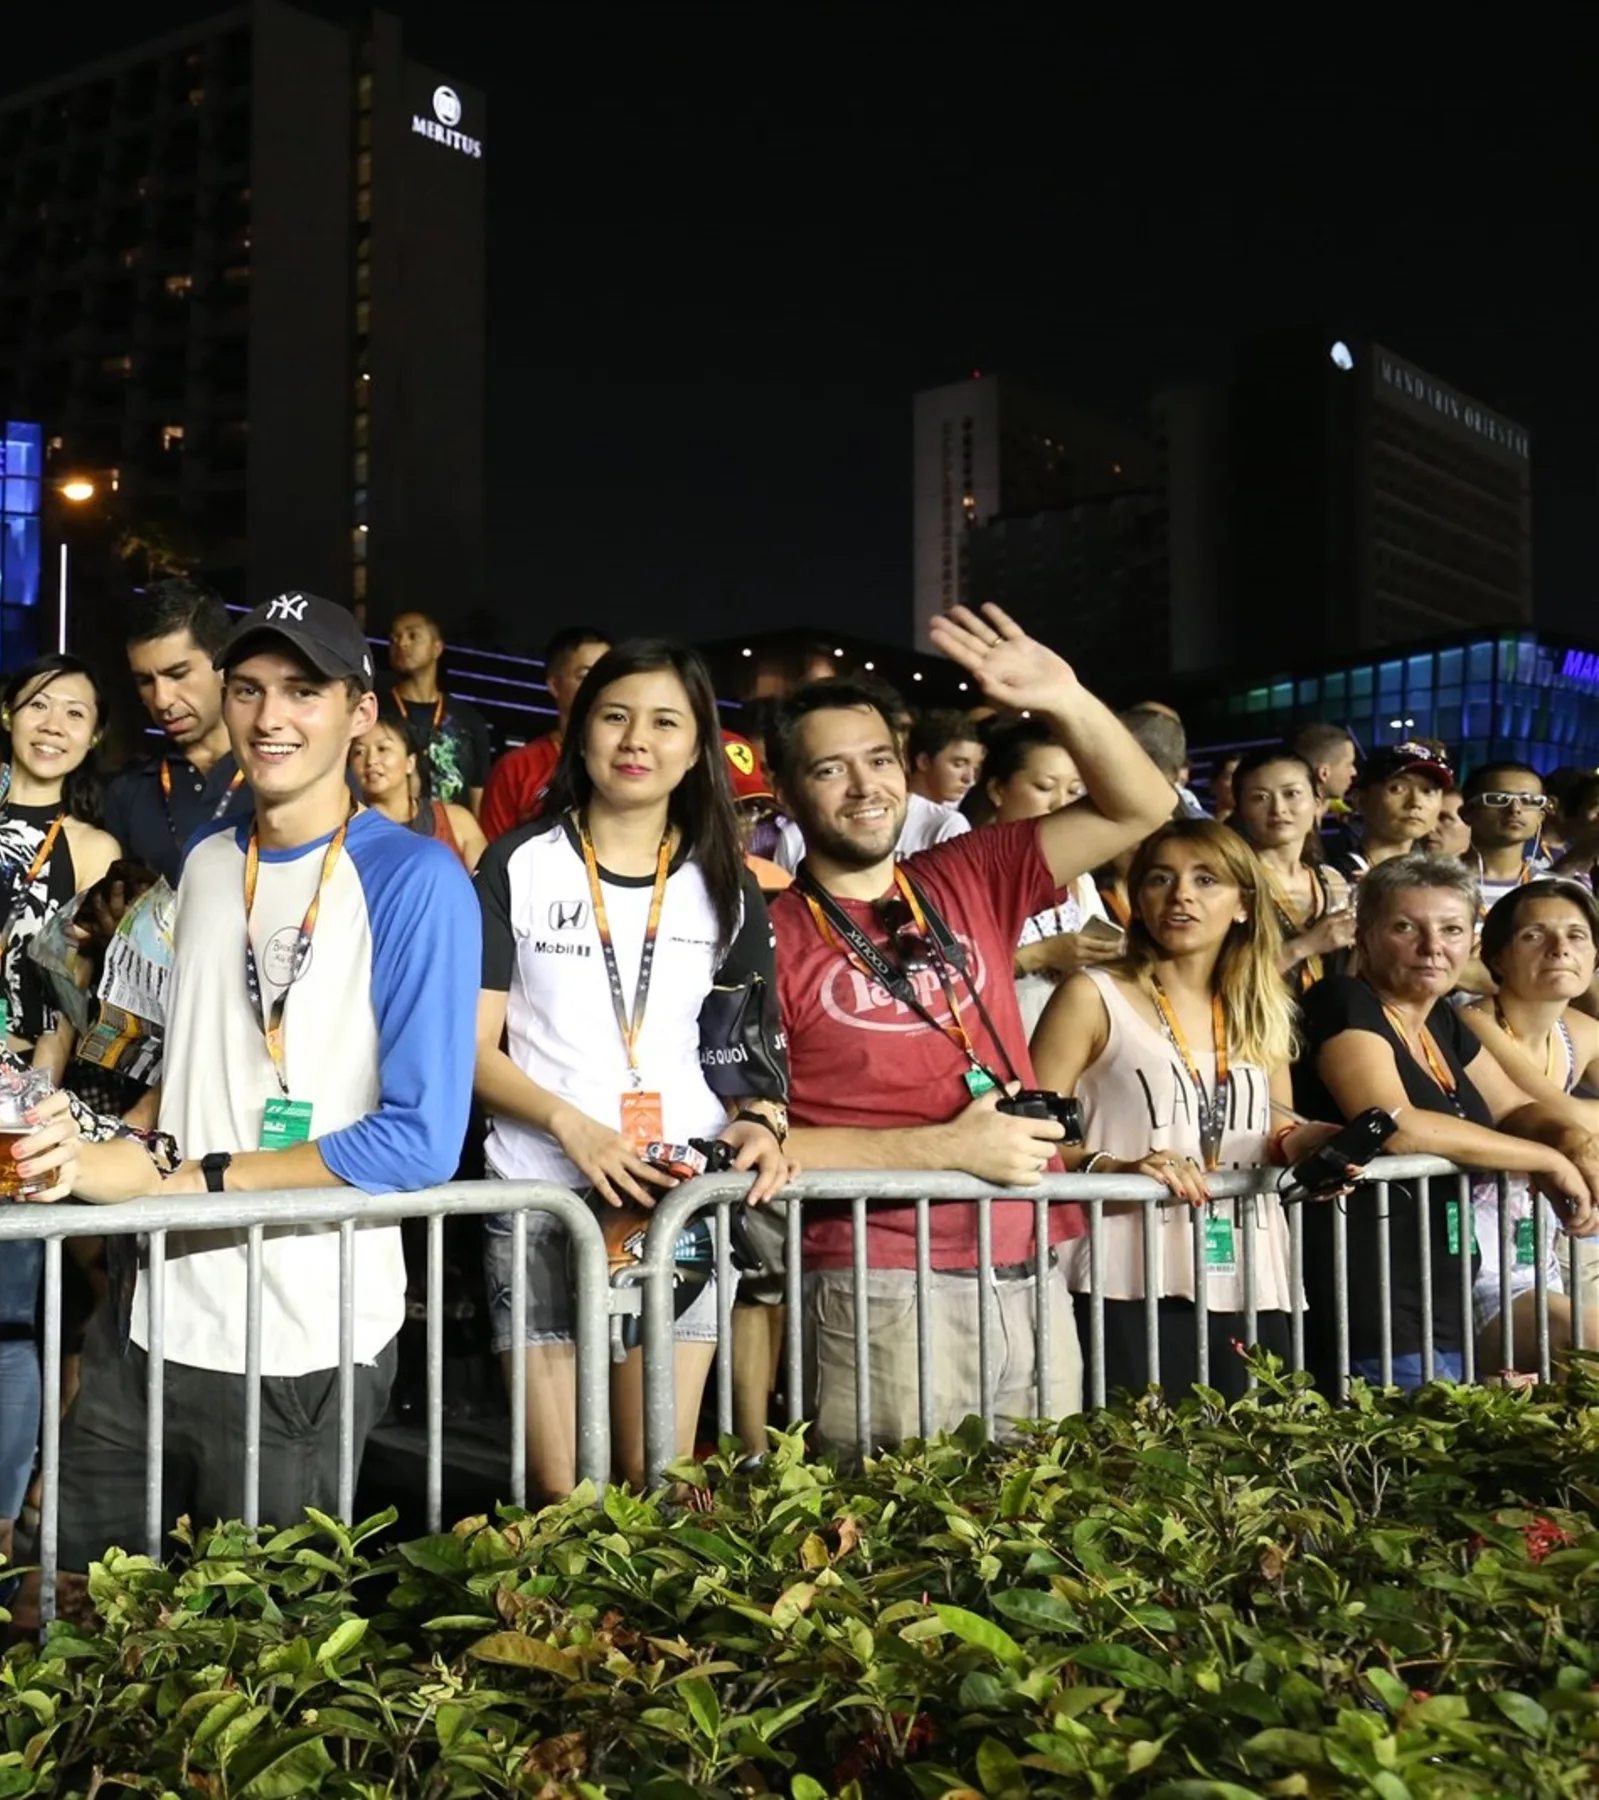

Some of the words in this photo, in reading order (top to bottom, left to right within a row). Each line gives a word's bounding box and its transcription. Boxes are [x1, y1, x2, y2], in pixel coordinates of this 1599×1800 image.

[411, 114, 482, 159] MERITUS
[1380, 358, 1459, 421] MANDARIN
[1464, 405, 1529, 460] ORIENTAL
[266, 594, 309, 621] NY
[534, 941, 575, 955] Mobil
